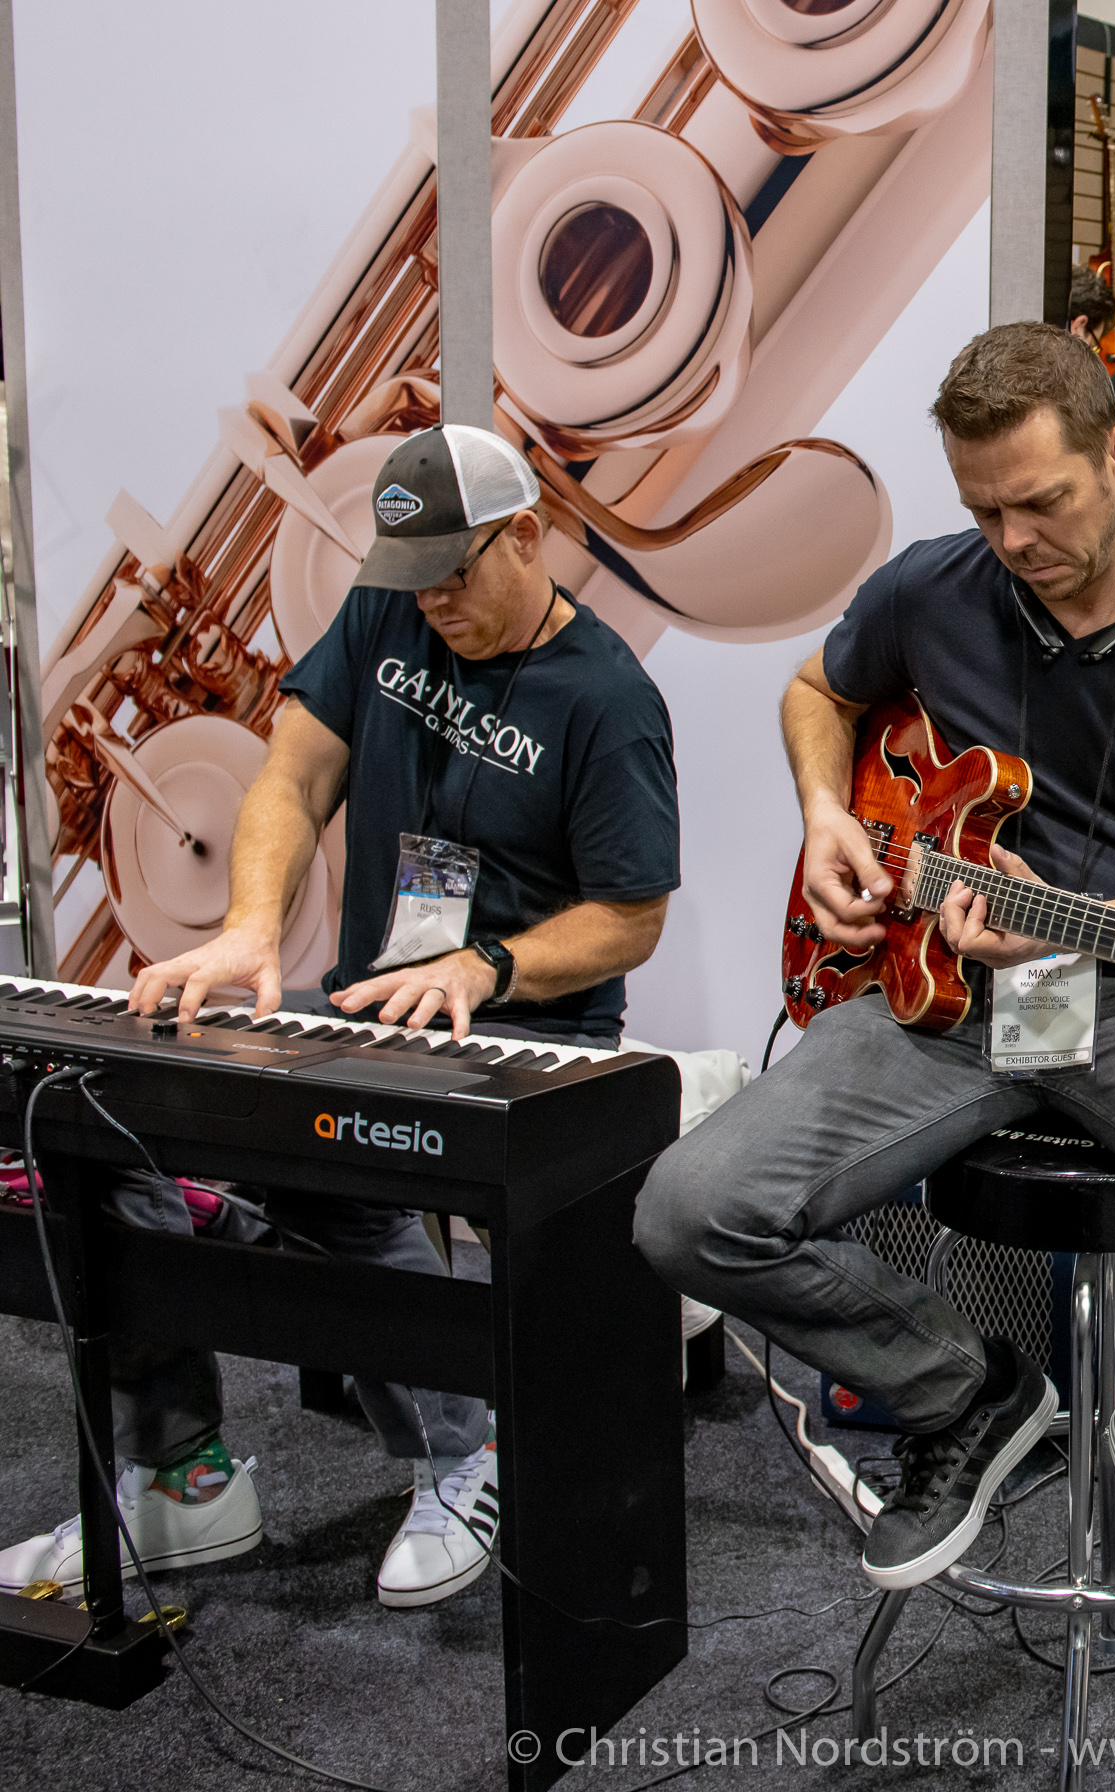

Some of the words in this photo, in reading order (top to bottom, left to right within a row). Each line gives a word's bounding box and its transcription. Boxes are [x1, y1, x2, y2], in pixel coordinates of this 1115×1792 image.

[378, 500, 416, 510] PATAGONIA
[420, 903, 442, 916] RUSS
[1028, 968, 1053, 979] MAX
[1056, 968, 1062, 979] J
[1017, 995, 1071, 1004] ELECTRO-VOICE
[1019, 1003, 1058, 1011] BURNSVILLE,
[1005, 1055, 1050, 1065] EXHIBITOR
[1051, 1052, 1078, 1063] GUEST
[314, 1111, 444, 1156] artesia
[1025, 1133, 1095, 1148] Guitars
